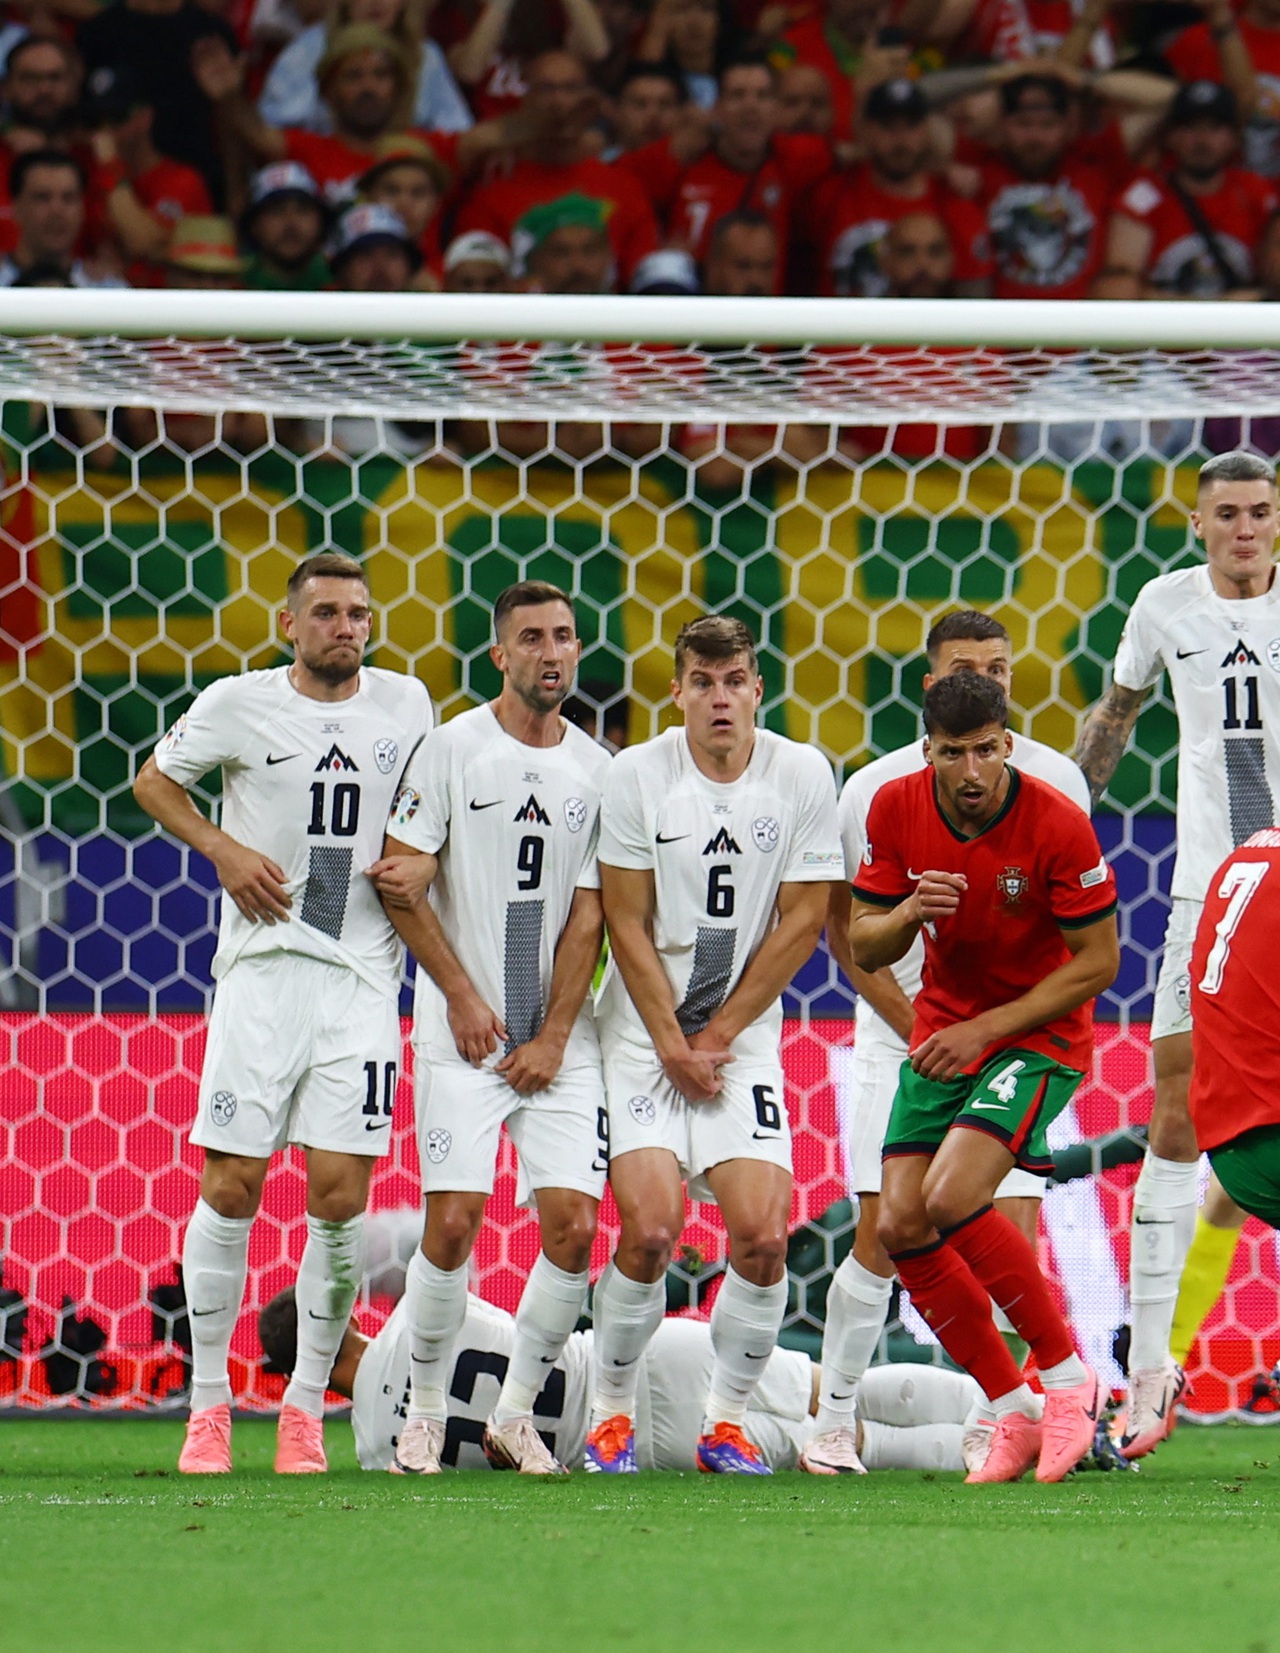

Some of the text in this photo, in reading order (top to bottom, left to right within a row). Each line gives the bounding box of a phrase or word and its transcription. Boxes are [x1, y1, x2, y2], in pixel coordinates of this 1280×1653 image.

[1222, 676, 1263, 730] 11
[307, 782, 360, 837] 10
[517, 835, 544, 891] 9
[706, 864, 735, 918] 6
[1198, 861, 1271, 995] 7
[362, 1061, 397, 1116] 10
[752, 1084, 781, 1131] 6
[987, 1059, 1027, 1104] 4
